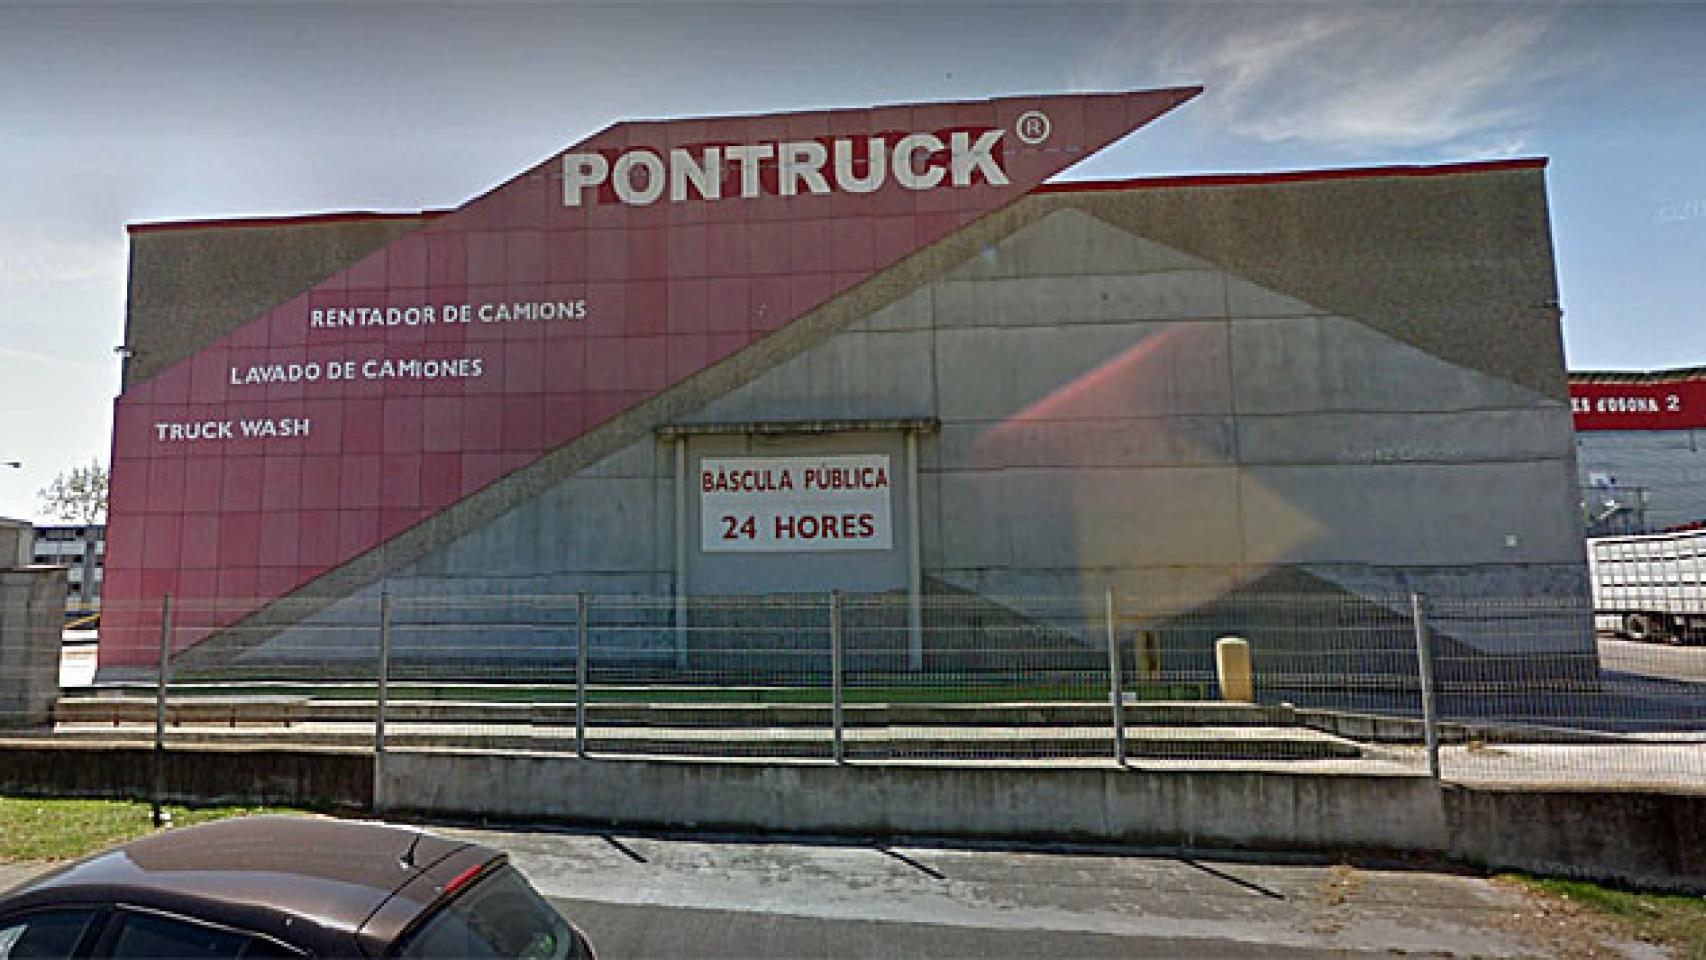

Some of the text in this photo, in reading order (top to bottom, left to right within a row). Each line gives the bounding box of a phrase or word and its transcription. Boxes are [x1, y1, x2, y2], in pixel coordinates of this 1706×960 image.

[562, 130, 1010, 206] PONTRUCK
[310, 300, 587, 328] RENTADOR DE CAMIONS
[230, 358, 483, 385] LAVADO DE CAMIONES
[1666, 394, 1680, 412] 2
[155, 418, 310, 441] TRUCK WASH
[721, 513, 874, 540] 24 HORES
